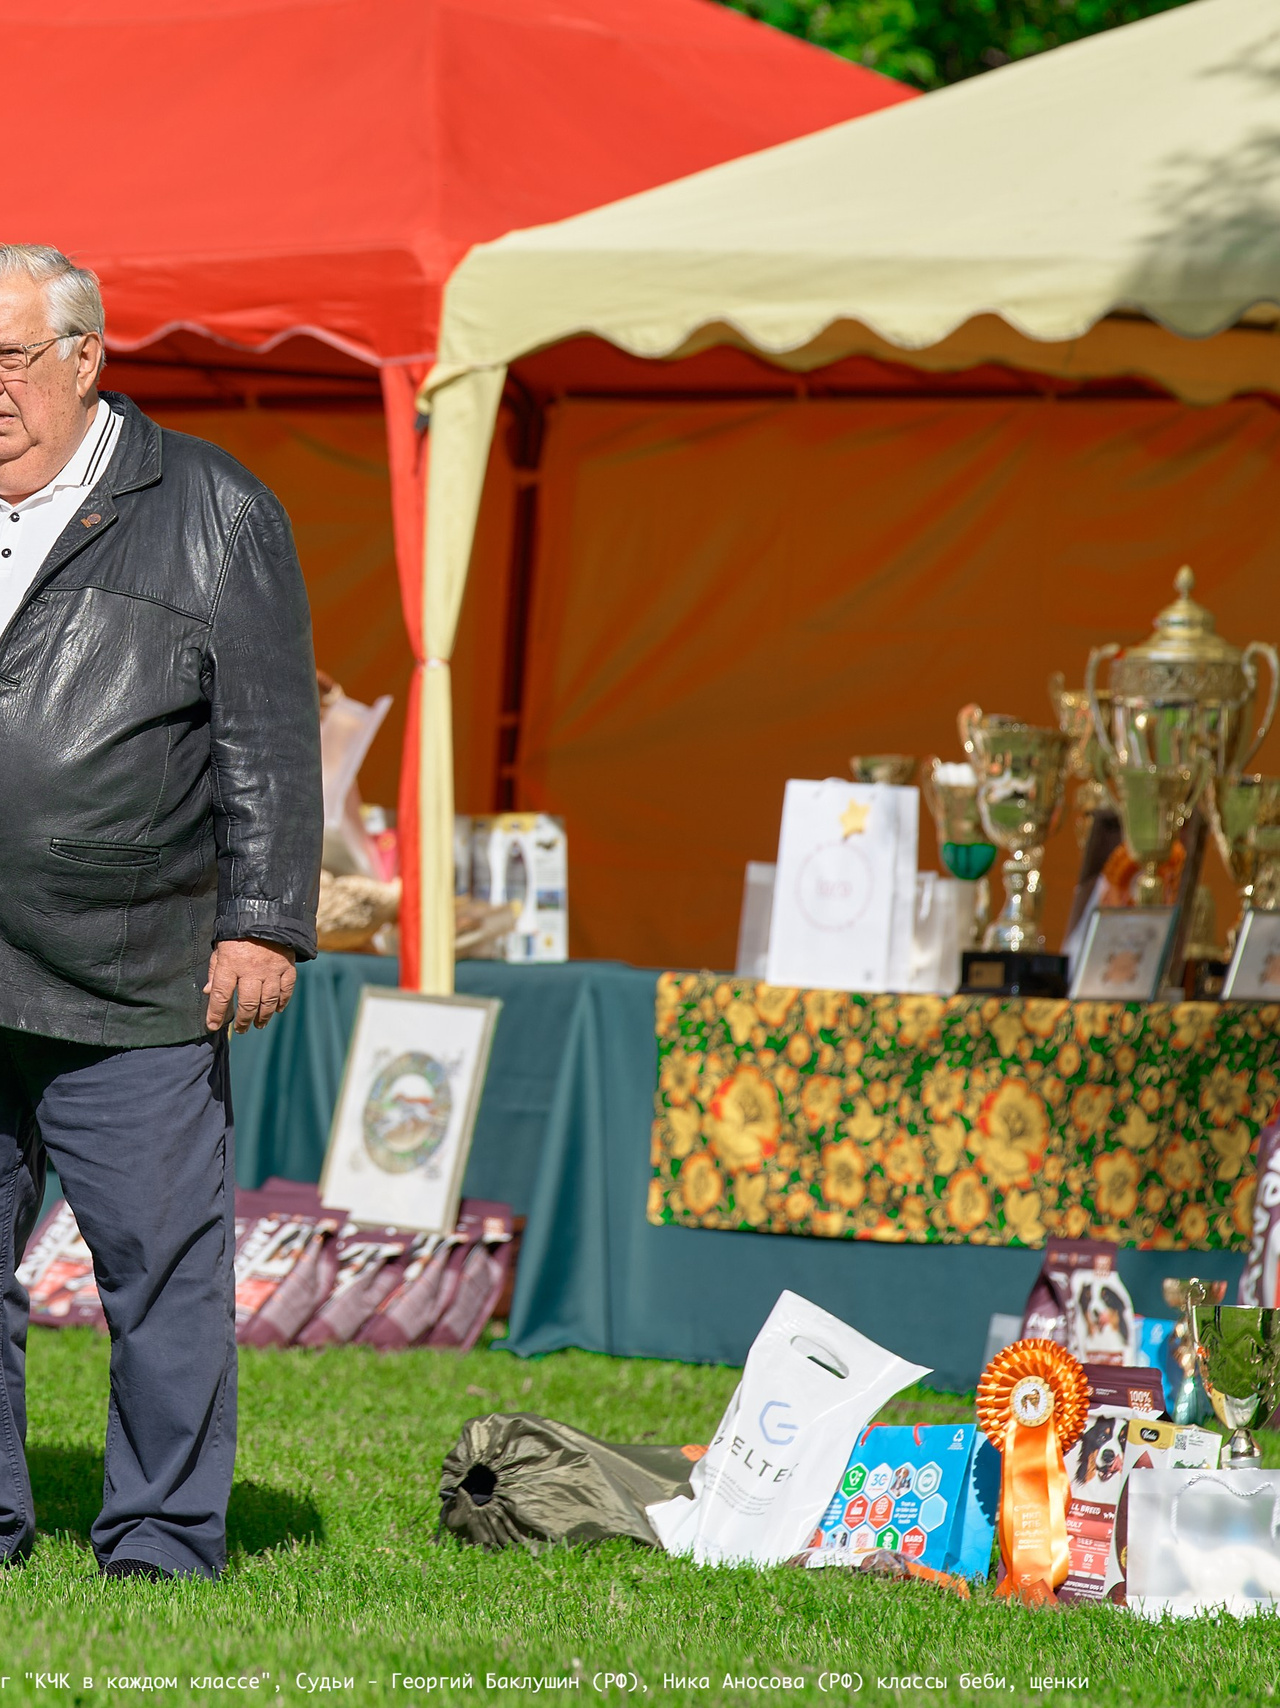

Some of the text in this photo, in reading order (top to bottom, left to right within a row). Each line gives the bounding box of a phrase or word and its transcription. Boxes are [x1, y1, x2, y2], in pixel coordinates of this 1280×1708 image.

[1071, 1502, 1080, 1511] LL
[1066, 1519, 1083, 1528] DULT
[904, 1534, 923, 1543] BARS
